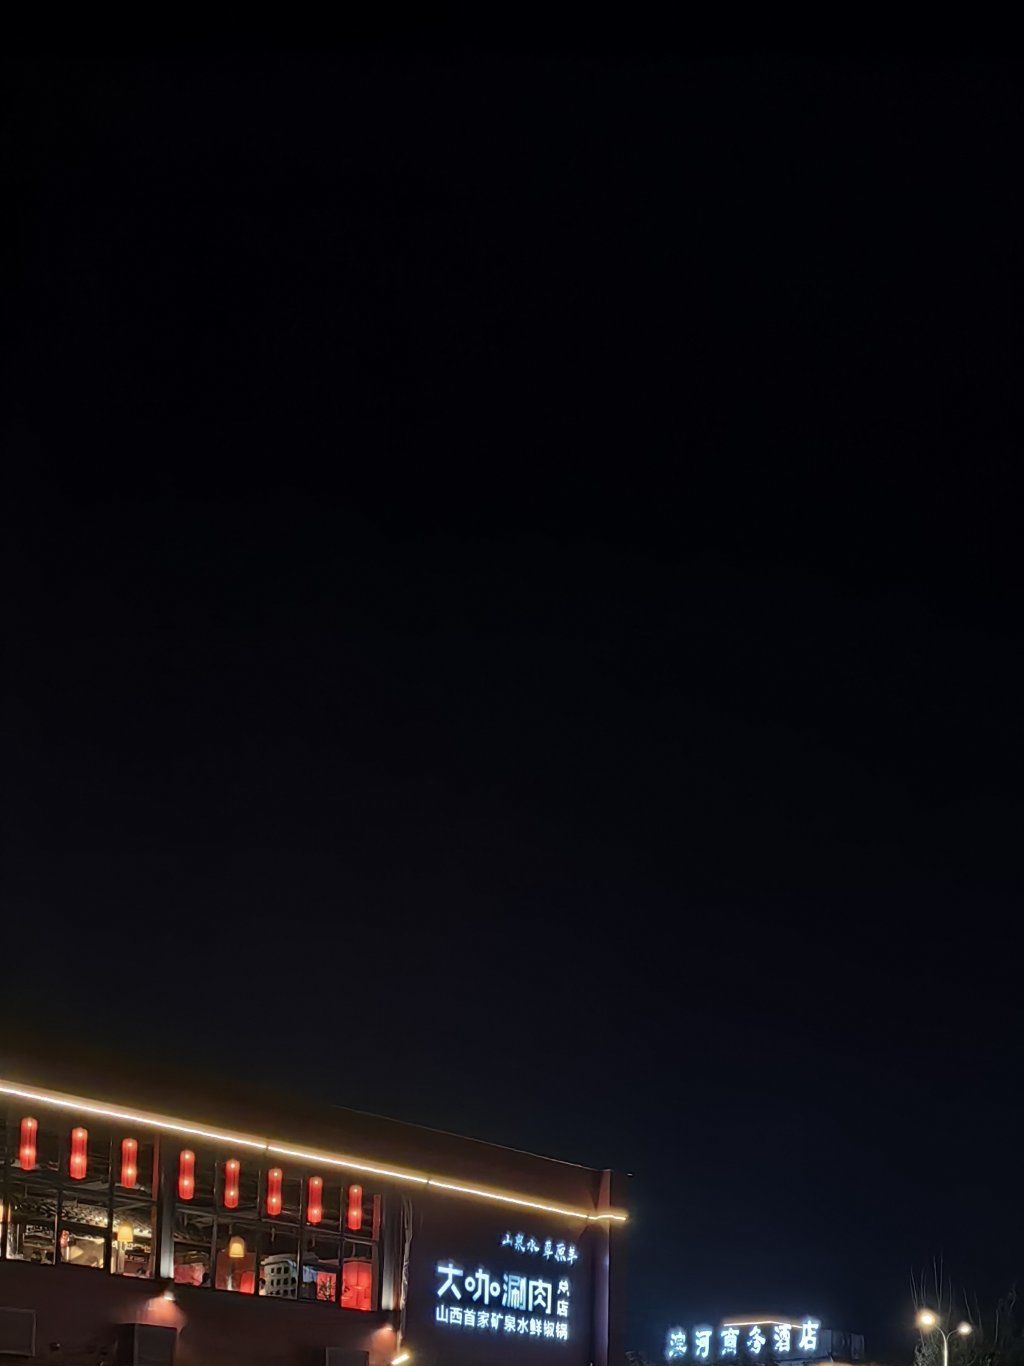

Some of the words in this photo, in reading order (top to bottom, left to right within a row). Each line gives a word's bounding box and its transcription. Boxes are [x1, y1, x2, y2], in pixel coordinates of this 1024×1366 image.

[436, 1263, 553, 1315] 大咖涮肉
[668, 1320, 820, 1358] 滨河商务酒店
